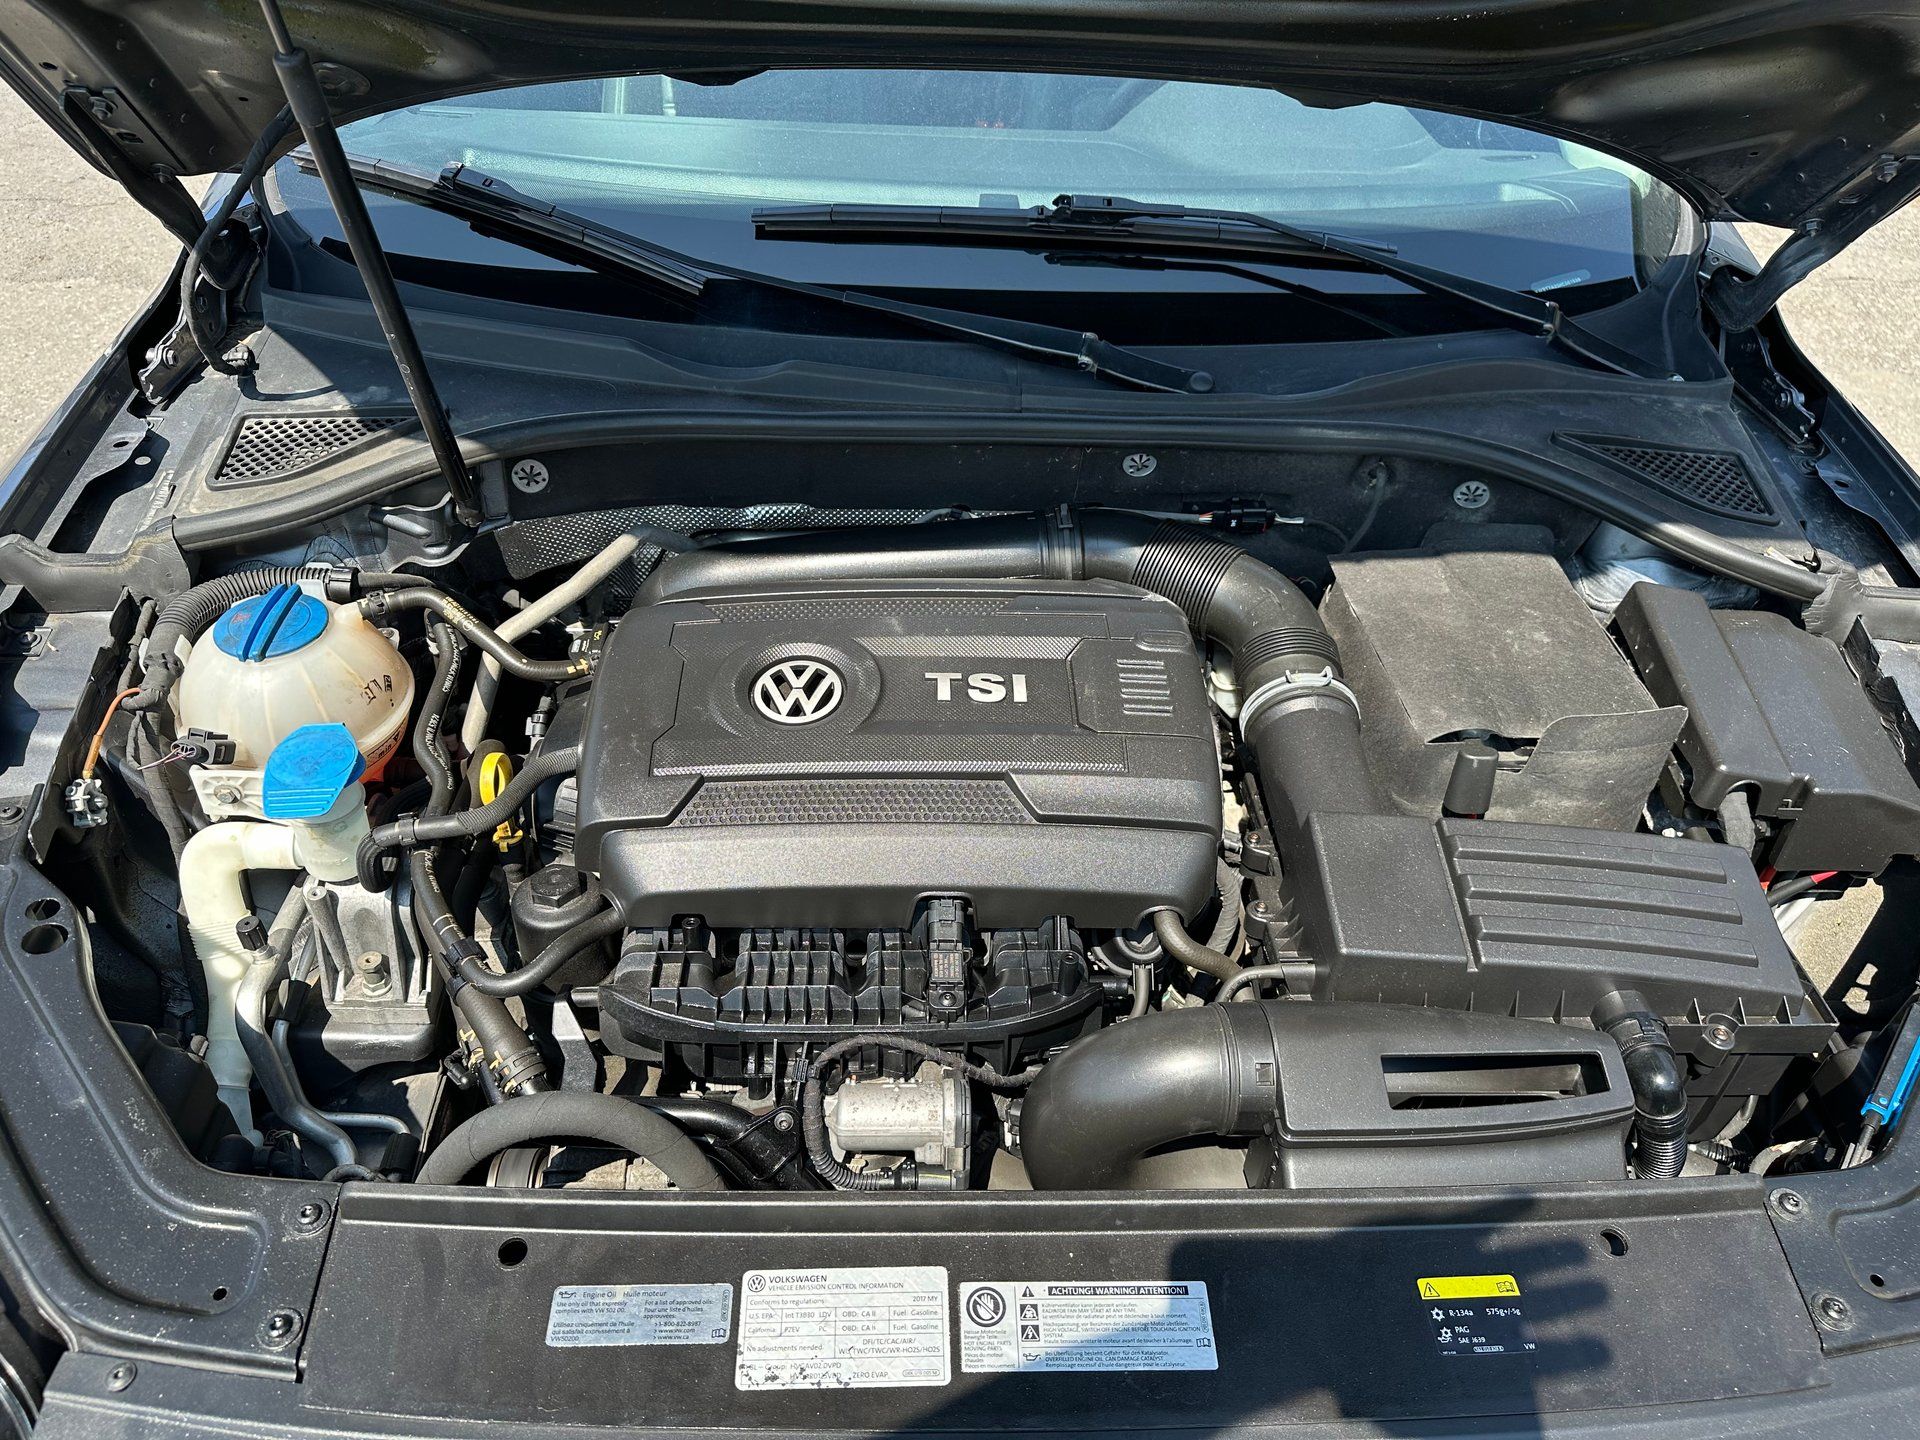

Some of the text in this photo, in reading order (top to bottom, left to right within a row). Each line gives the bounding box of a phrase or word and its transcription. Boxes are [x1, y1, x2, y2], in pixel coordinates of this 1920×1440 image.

[924, 671, 1028, 703] TSI
[753, 660, 843, 724] VW
[768, 1275, 828, 1284] VOLKSWAGEN
[768, 1284, 793, 1292] VEHICLE
[794, 1283, 826, 1291] EMISSION
[858, 1282, 904, 1290] INFORMATION
[1051, 1285, 1186, 1295] ACHTUNG! WARNING! ATTENTION!
[582, 1291, 606, 1300] Engine
[606, 1290, 617, 1299] Oil
[622, 1290, 641, 1298] Huile
[602, 1300, 628, 1308] expressly
[749, 1298, 780, 1306] Conforms
[1448, 1307, 1521, 1317] R-134a 575g+/-5g
[893, 1323, 939, 1331] Fuel: Gasoline
[1454, 1325, 1470, 1334] PAG
[756, 1345, 798, 1353] adjustments
